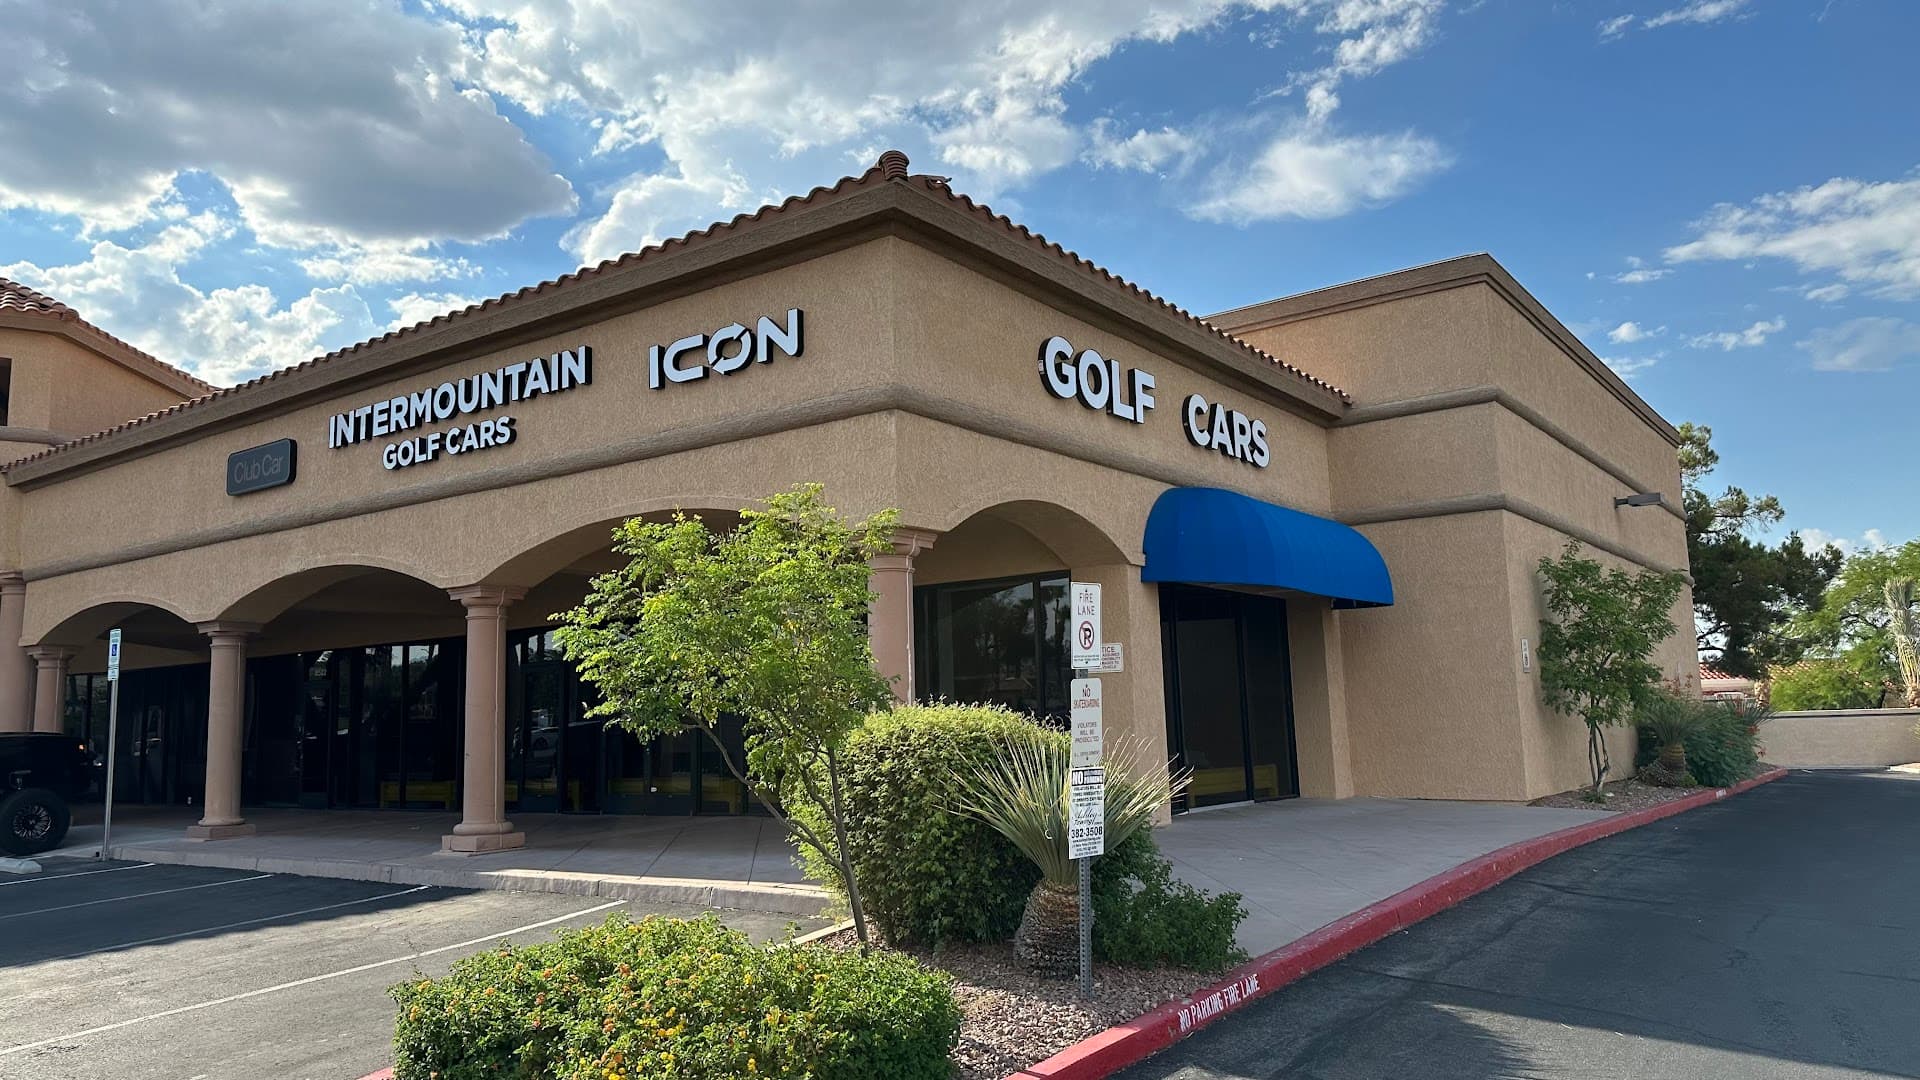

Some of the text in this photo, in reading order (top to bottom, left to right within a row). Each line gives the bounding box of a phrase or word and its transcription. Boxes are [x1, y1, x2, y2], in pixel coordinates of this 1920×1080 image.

[649, 308, 801, 389] ICON
[329, 346, 589, 448] INTERMOUNTAIN
[1039, 336, 1270, 468] GOLF CARS
[383, 416, 513, 470] GOLF CARS
[234, 454, 284, 484] Club Car
[1077, 605, 1095, 616] LANE
[1079, 592, 1093, 603] FIRE
[1083, 688, 1091, 697] NO
[1072, 770, 1083, 785] NO
[1178, 974, 1260, 1032] NO PARKING FIRE LANE
